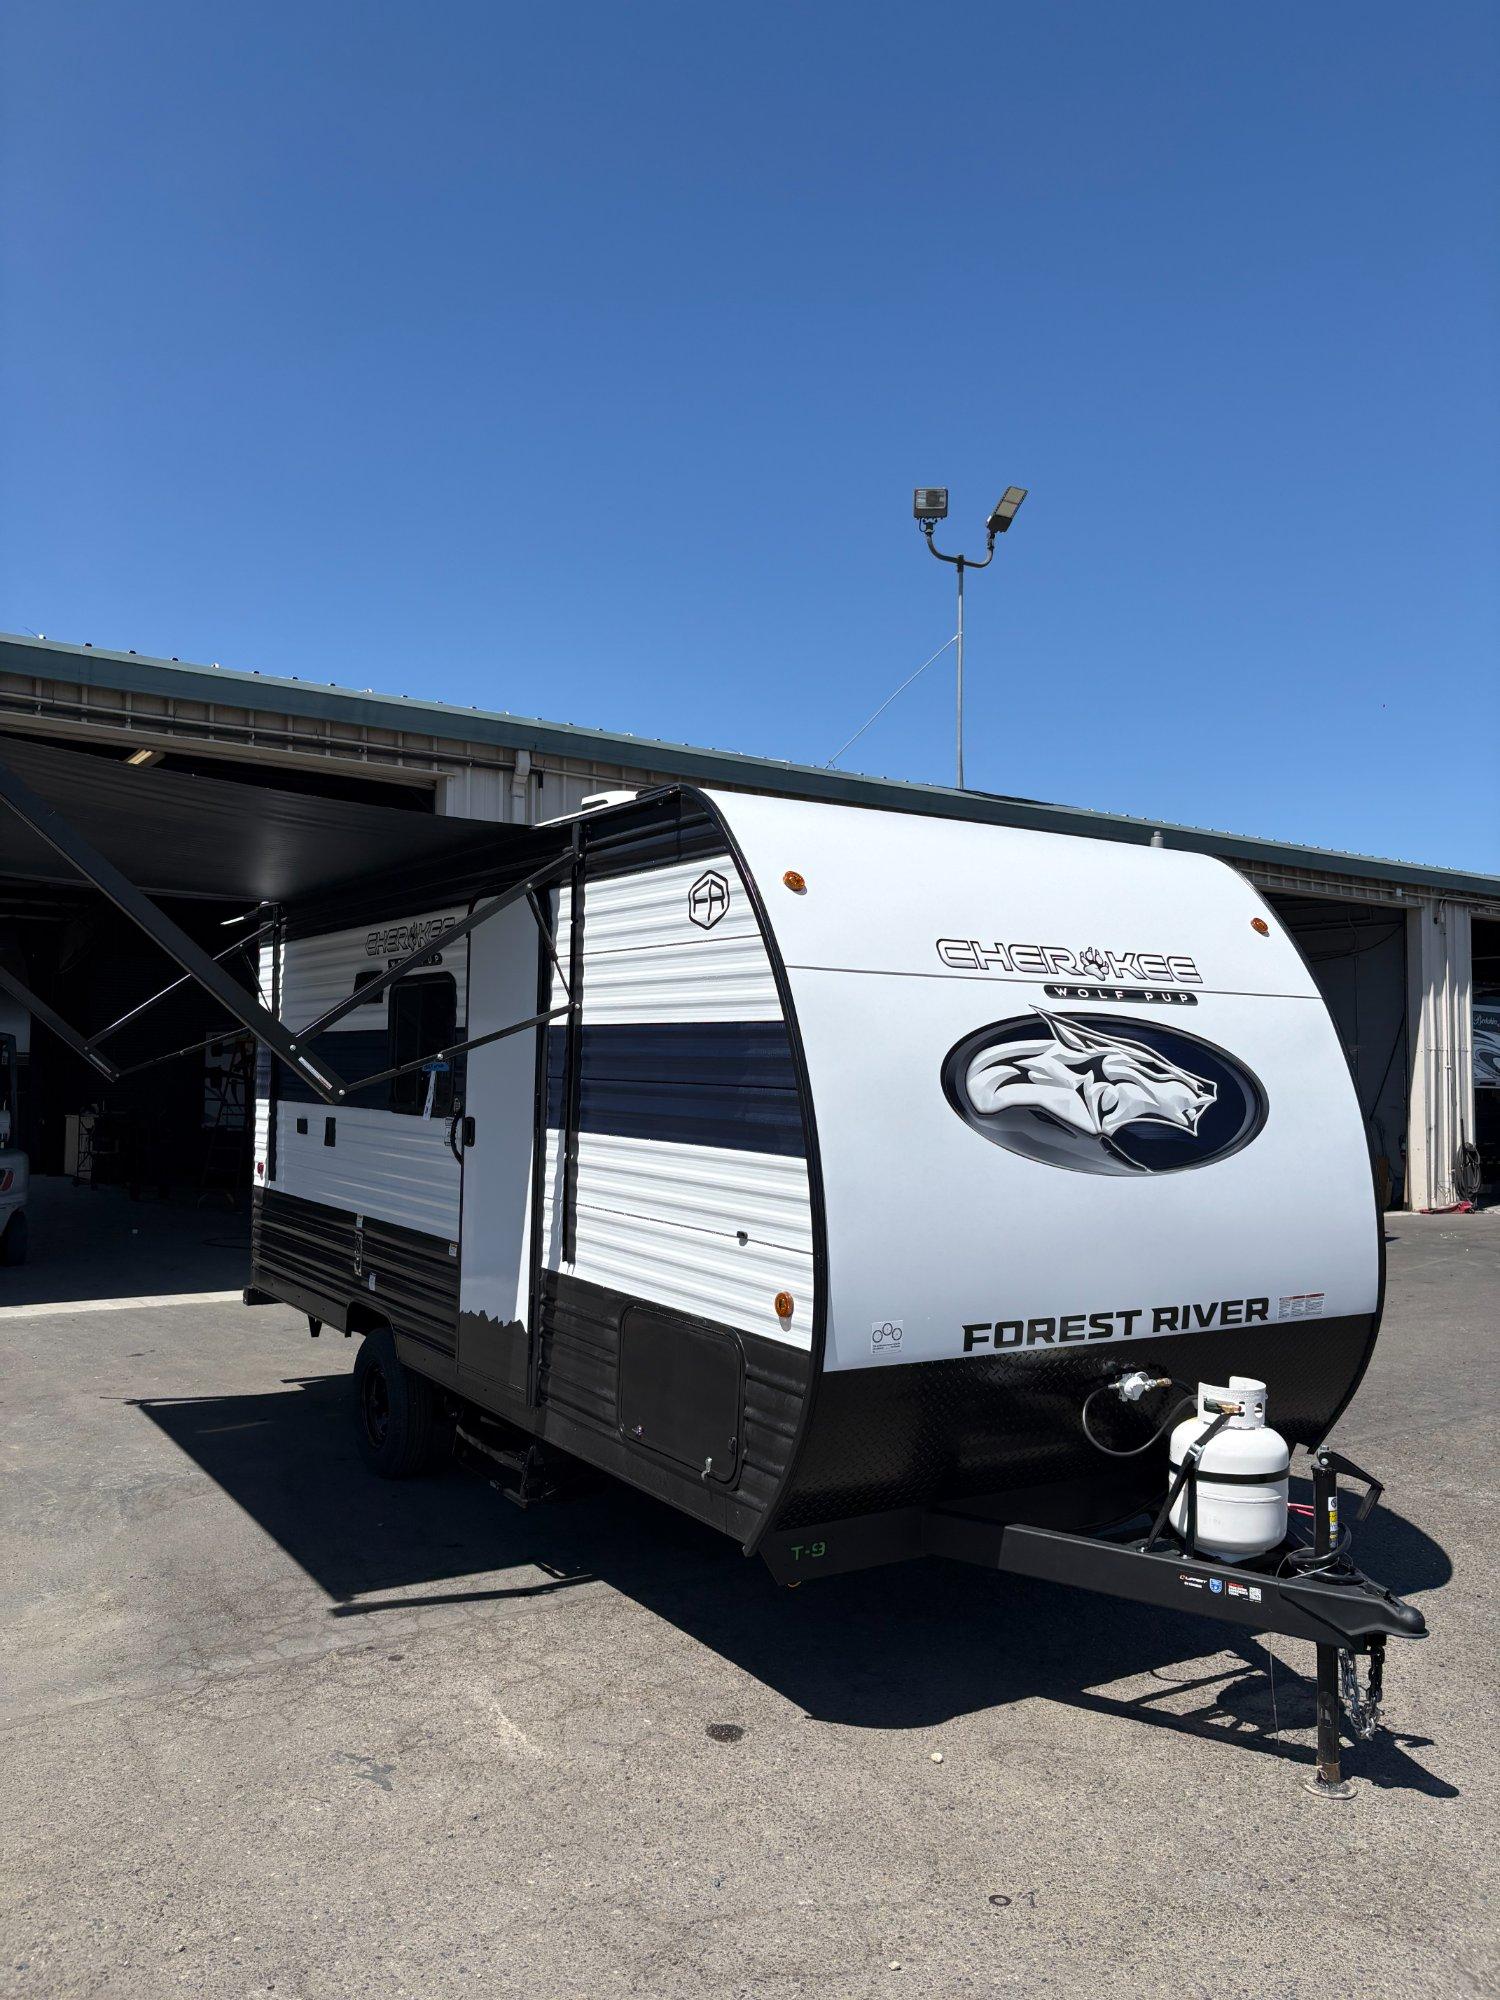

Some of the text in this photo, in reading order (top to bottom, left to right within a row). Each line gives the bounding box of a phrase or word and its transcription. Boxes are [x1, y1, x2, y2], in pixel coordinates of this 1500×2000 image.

[1054, 986, 1188, 1004] WOLF PUP
[962, 1310, 1142, 1352] FOREST
[1151, 1297, 1270, 1333] RIVER
[790, 1541, 826, 1560] T-9
